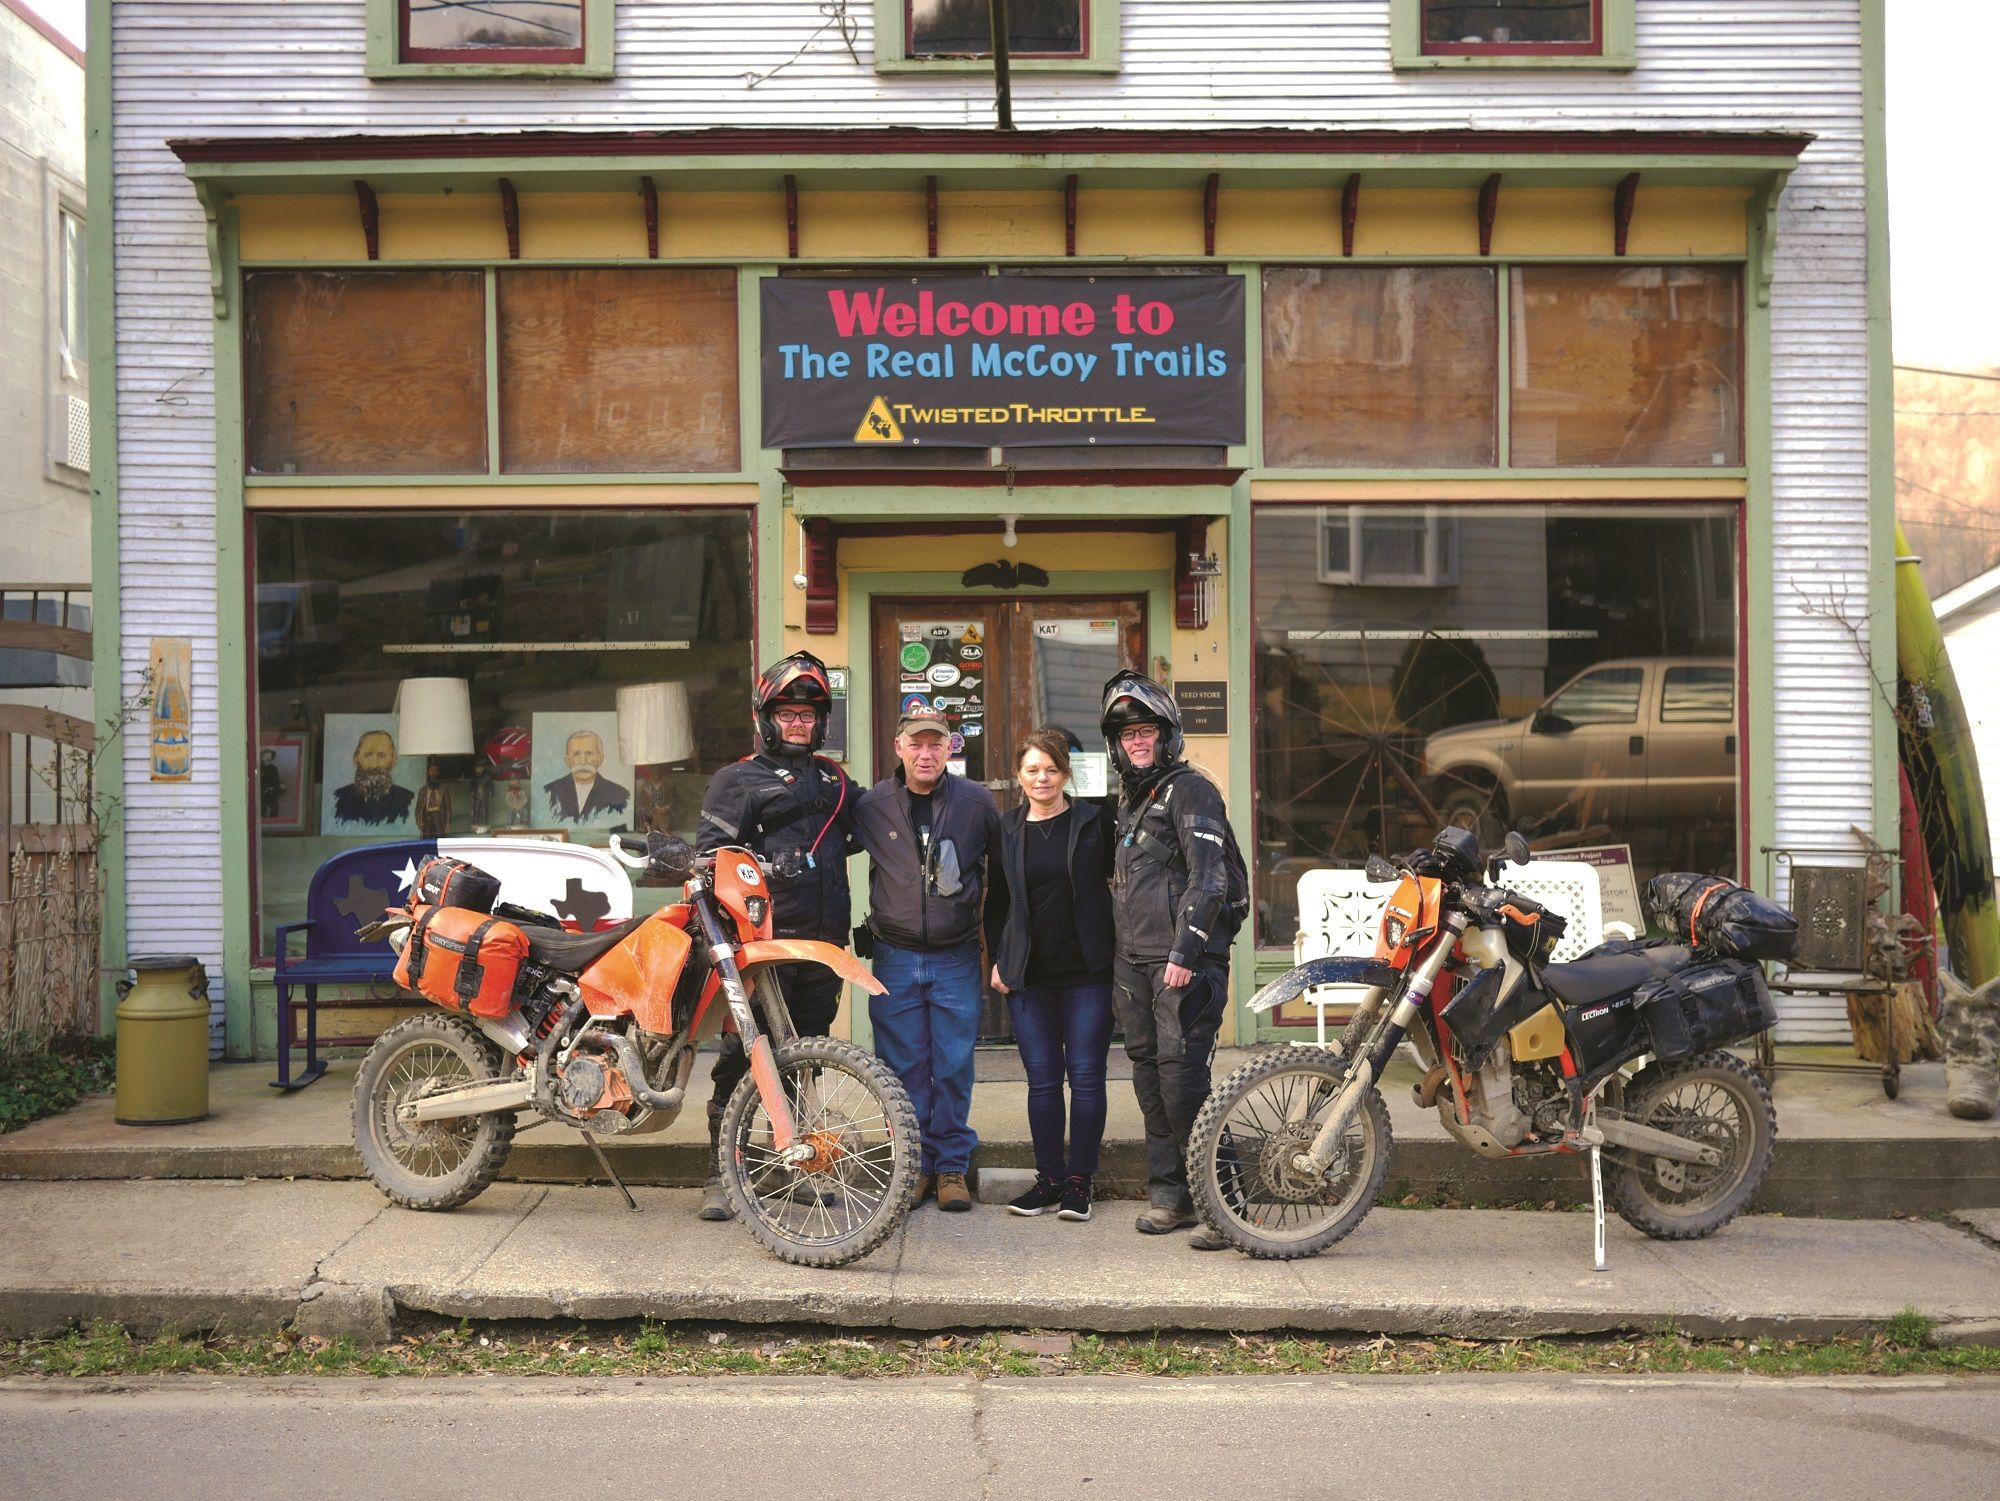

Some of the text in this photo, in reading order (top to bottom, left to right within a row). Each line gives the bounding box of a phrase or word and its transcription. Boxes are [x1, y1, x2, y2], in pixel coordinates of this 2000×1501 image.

[828, 288, 1174, 337] Welcome to
[778, 342, 1227, 382] The Real McCoy Trails
[1039, 625, 1057, 634] KAT
[1580, 851, 1602, 861] Project
[740, 866, 756, 880] KAT
[1581, 1006, 1609, 1022] LECTRON
